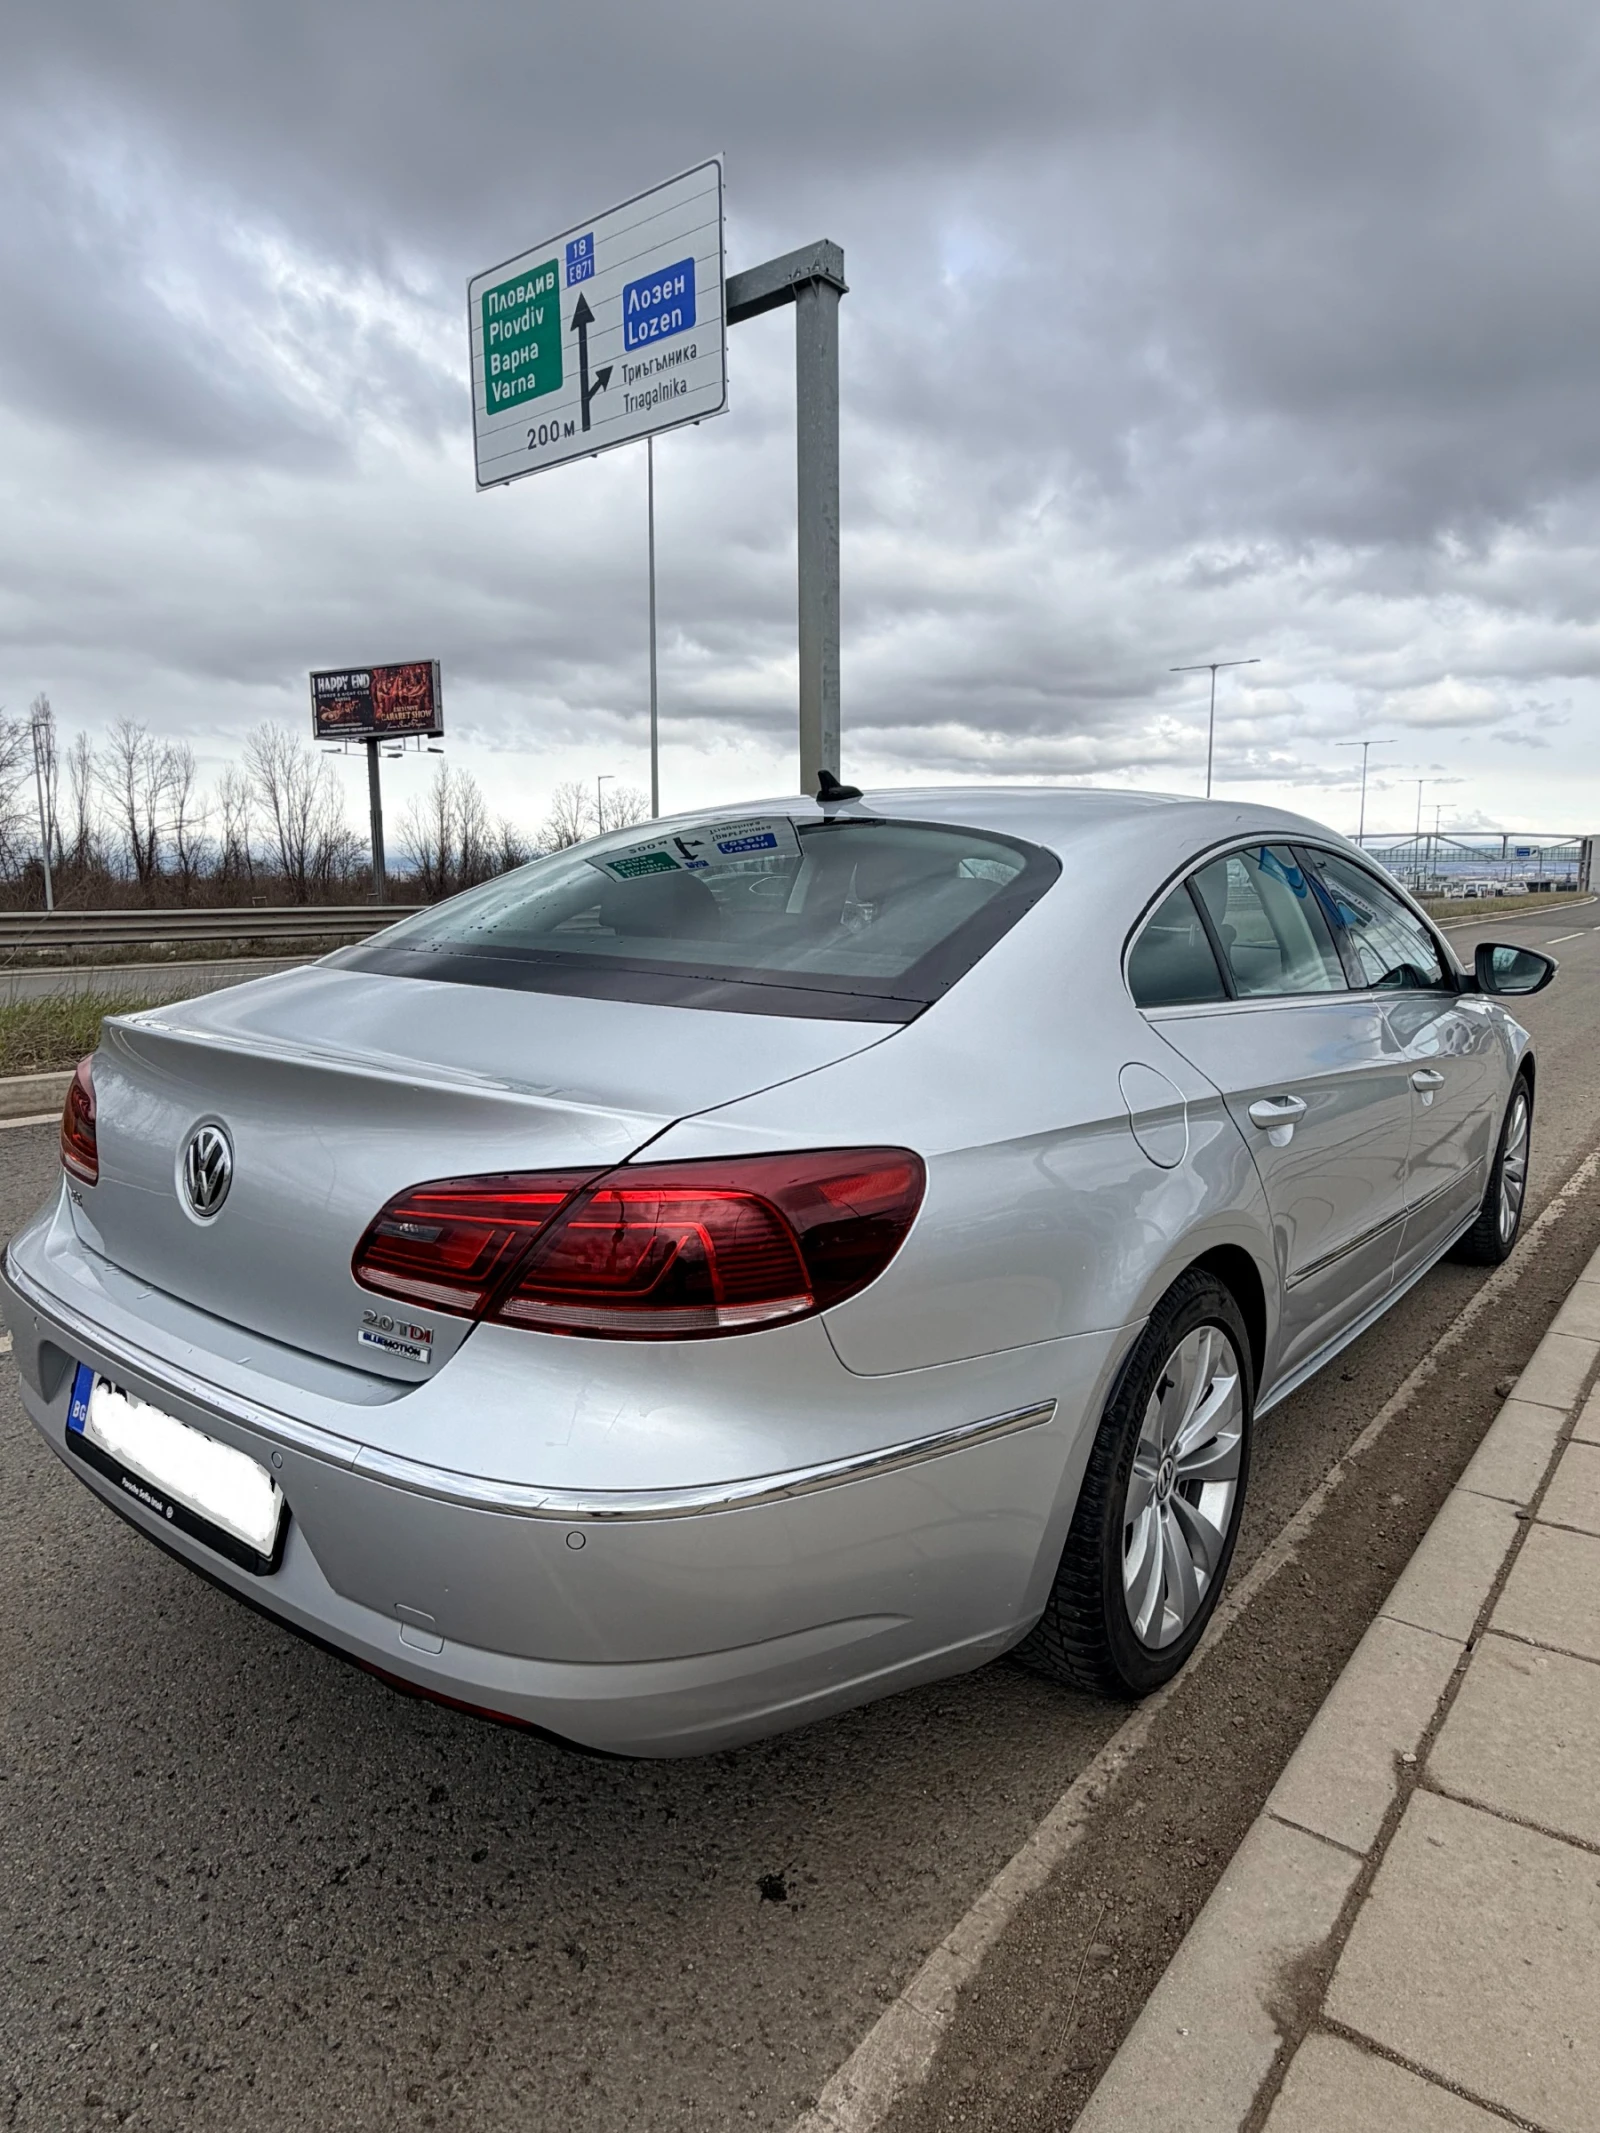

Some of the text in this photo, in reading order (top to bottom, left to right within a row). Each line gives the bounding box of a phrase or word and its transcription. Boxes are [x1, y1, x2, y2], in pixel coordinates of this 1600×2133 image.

[573, 239, 587, 258] 18
[569, 259, 592, 284] E871
[489, 272, 554, 316] Пловдив
[628, 275, 685, 315] Лозен
[490, 306, 544, 345] Plovdiv
[628, 308, 682, 345] Lozen
[491, 342, 539, 376] Варна
[622, 344, 697, 386] Триъгълника
[492, 373, 536, 402] Varna
[624, 379, 687, 413] Triagalnika
[527, 422, 559, 450] 200
[317, 673, 370, 692] HAPPY END
[381, 709, 432, 721] CABARET SHOW
[362, 1309, 434, 1345] 2.0 TDI
[363, 1332, 421, 1356] BLUEMOTION
[72, 1400, 87, 1422] BG
